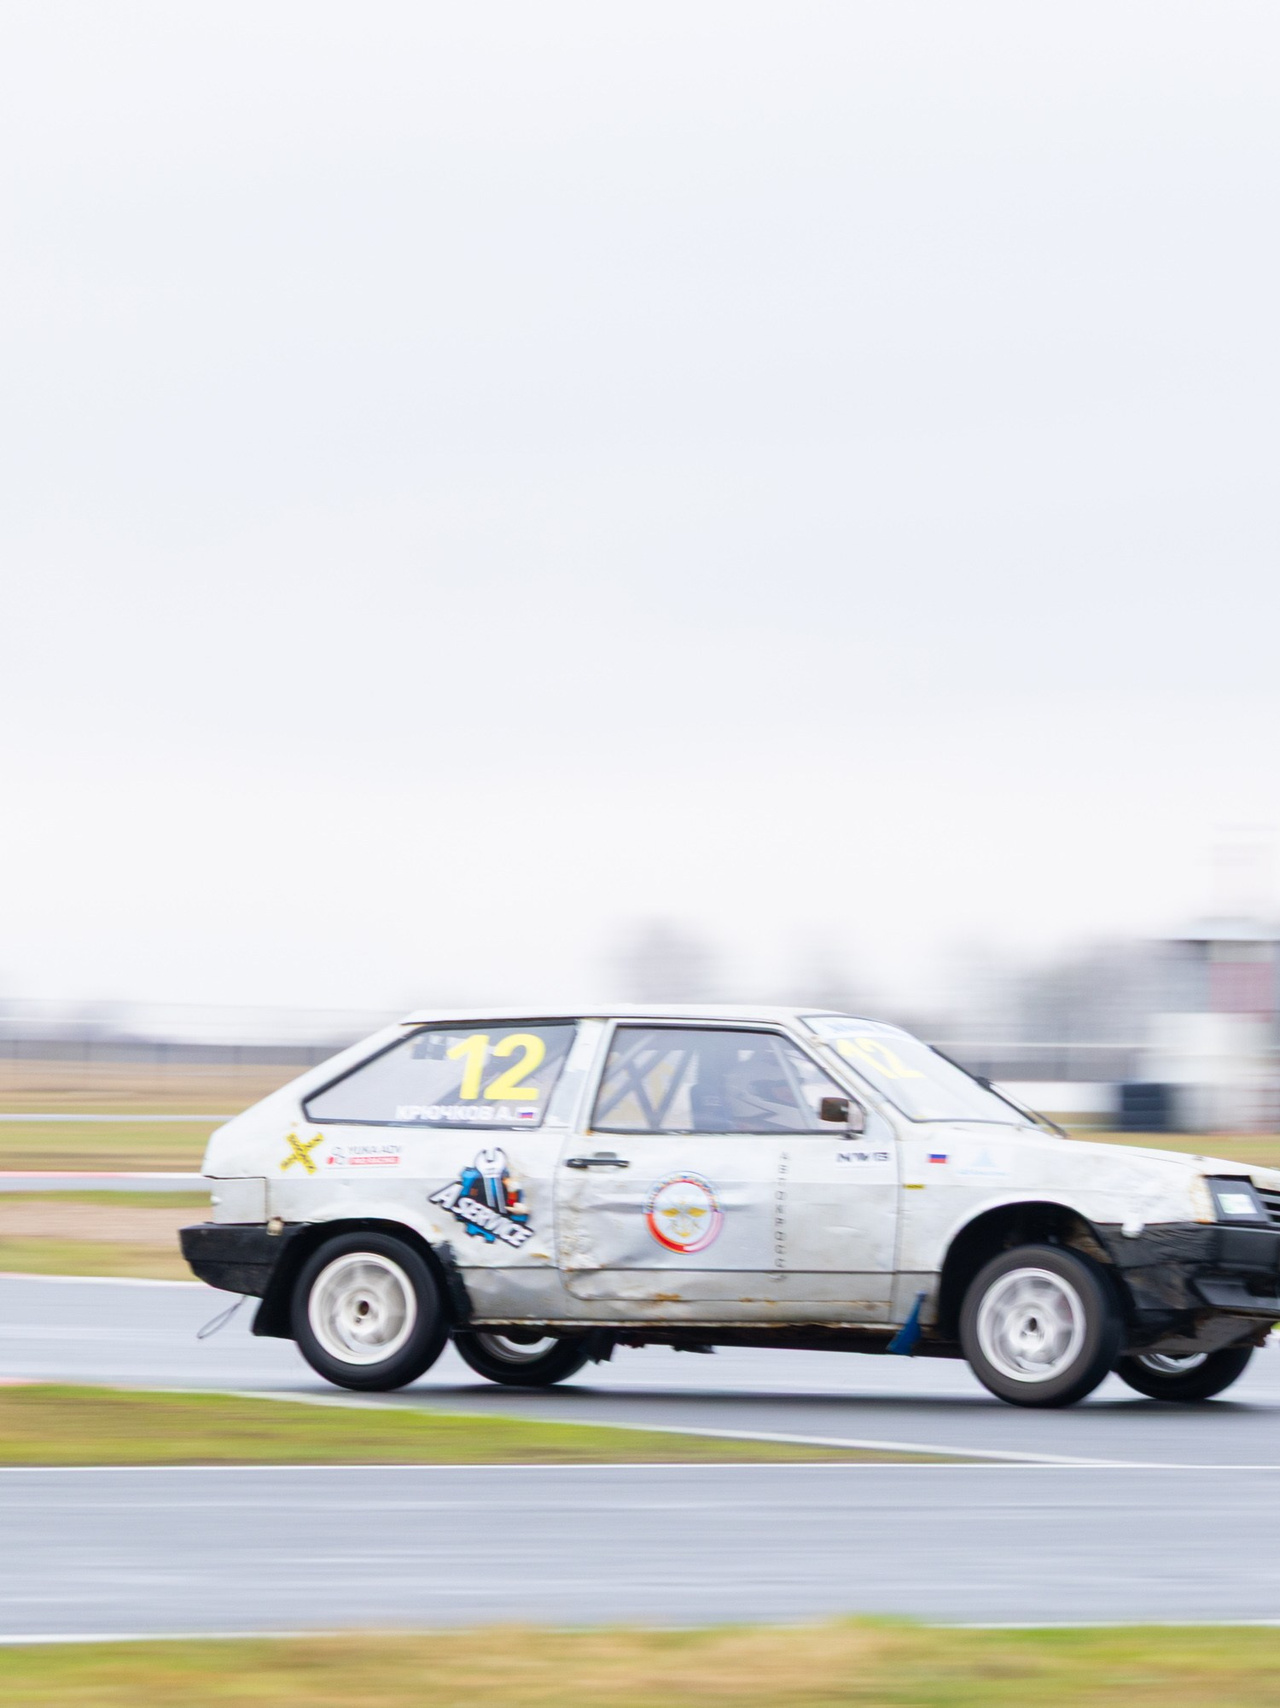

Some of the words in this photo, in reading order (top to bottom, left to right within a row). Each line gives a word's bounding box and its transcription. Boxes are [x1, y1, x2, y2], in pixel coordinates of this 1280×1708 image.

[446, 1033, 546, 1101] 12
[836, 1037, 927, 1079] 12
[395, 1106, 495, 1122] КРЮЧКОВ
[428, 1182, 464, 1208] A
[450, 1197, 534, 1246] SERVICE
